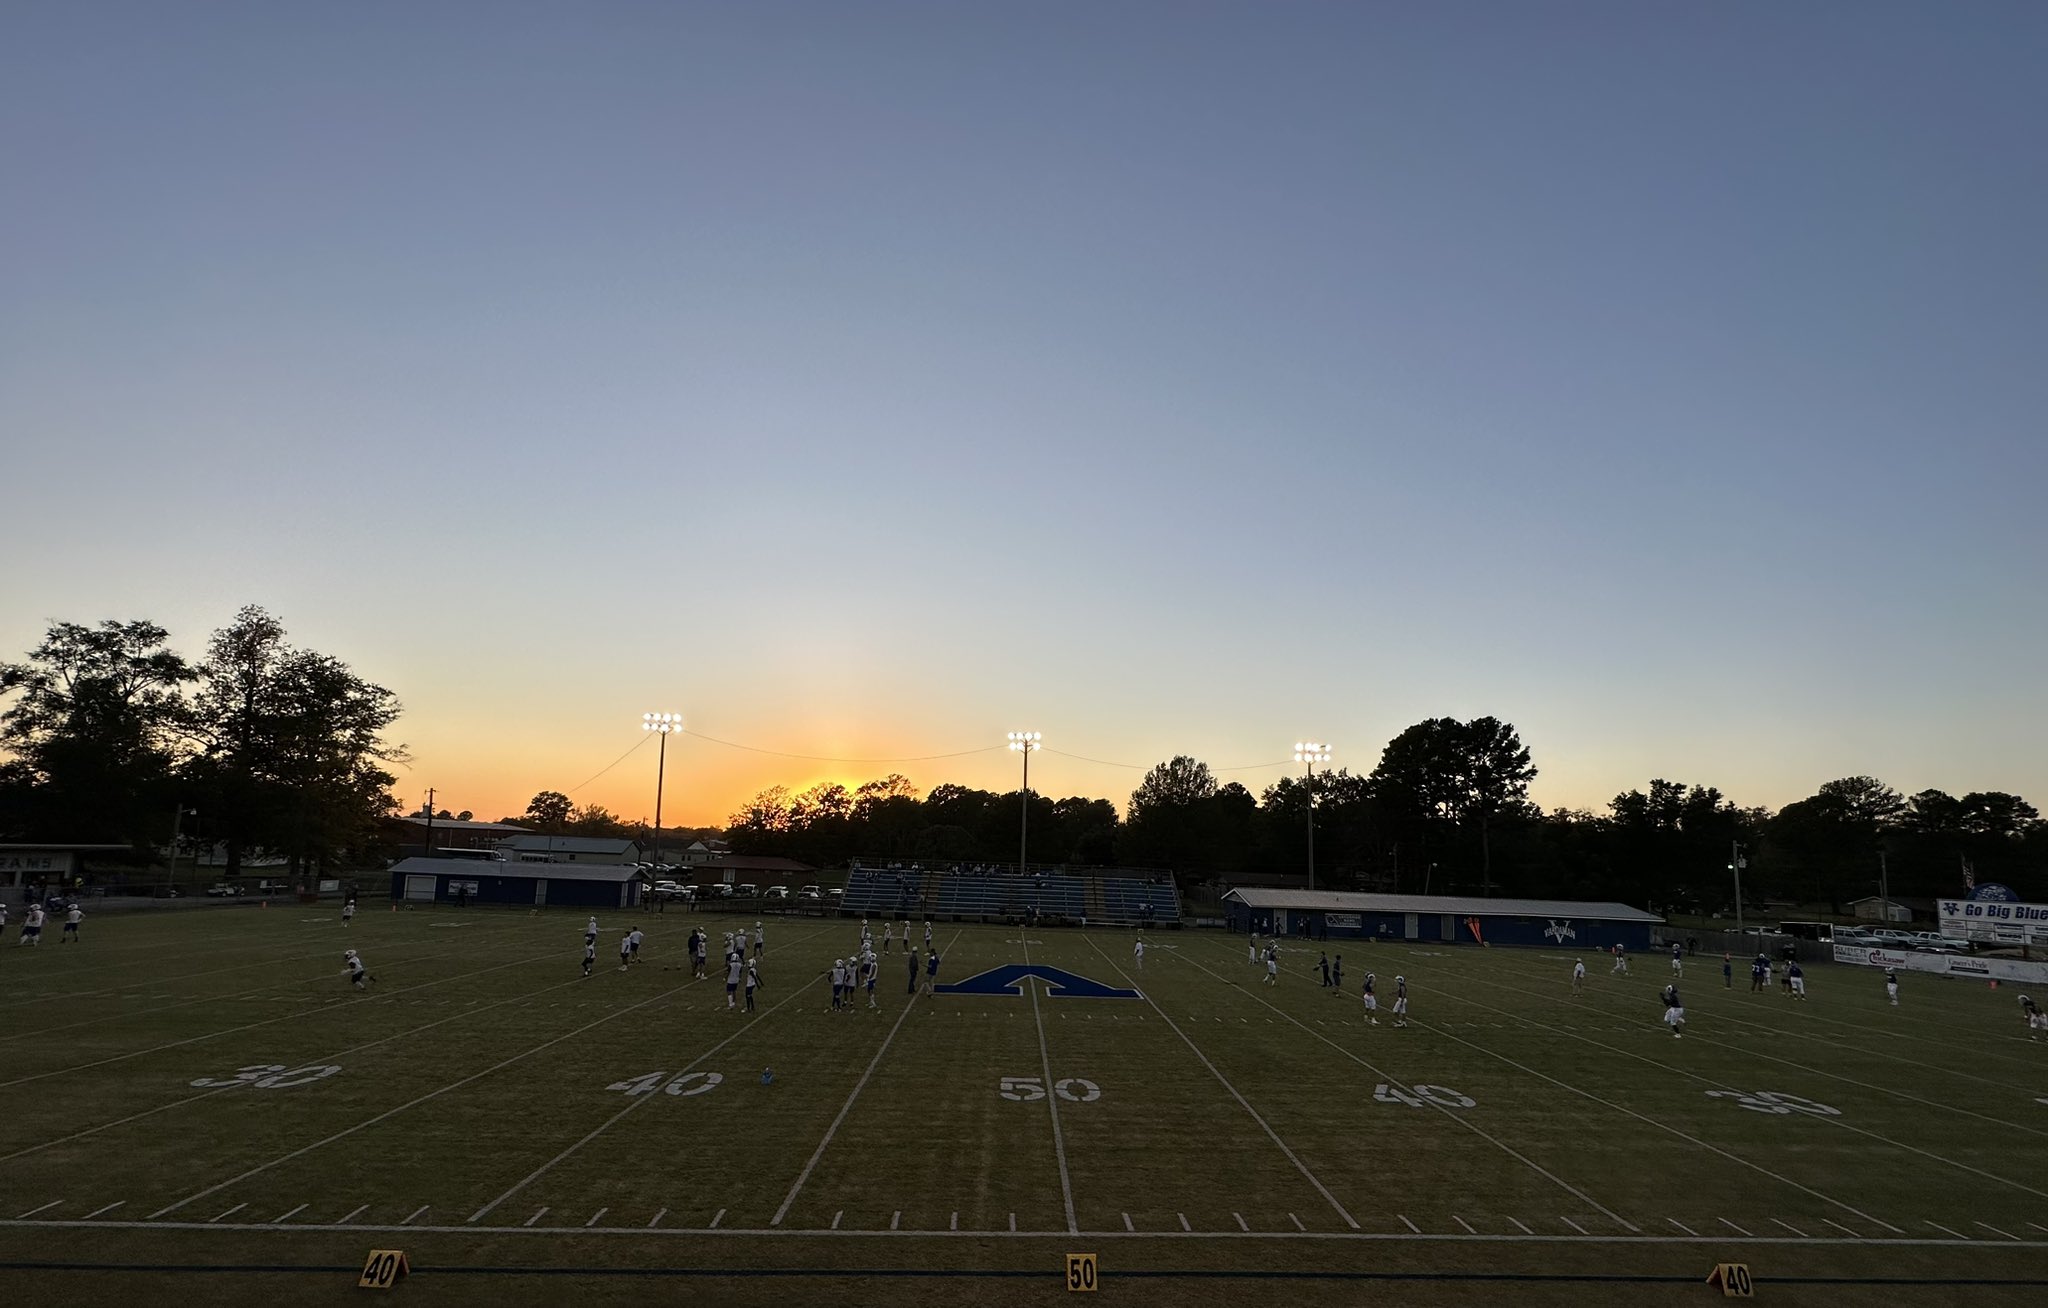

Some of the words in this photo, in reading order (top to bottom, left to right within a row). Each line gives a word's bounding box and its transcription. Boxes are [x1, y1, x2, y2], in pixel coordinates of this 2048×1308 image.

[1966, 904, 1982, 917] Go
[1987, 905, 2011, 919] Big
[2015, 906, 2048, 920] Blue
[604, 1071, 724, 1096] 40
[1000, 1076, 1101, 1102] 50
[1372, 1084, 1477, 1108] 40
[364, 1253, 395, 1285] 40
[1070, 1258, 1094, 1289] 50
[1727, 1265, 1750, 1295] 40
